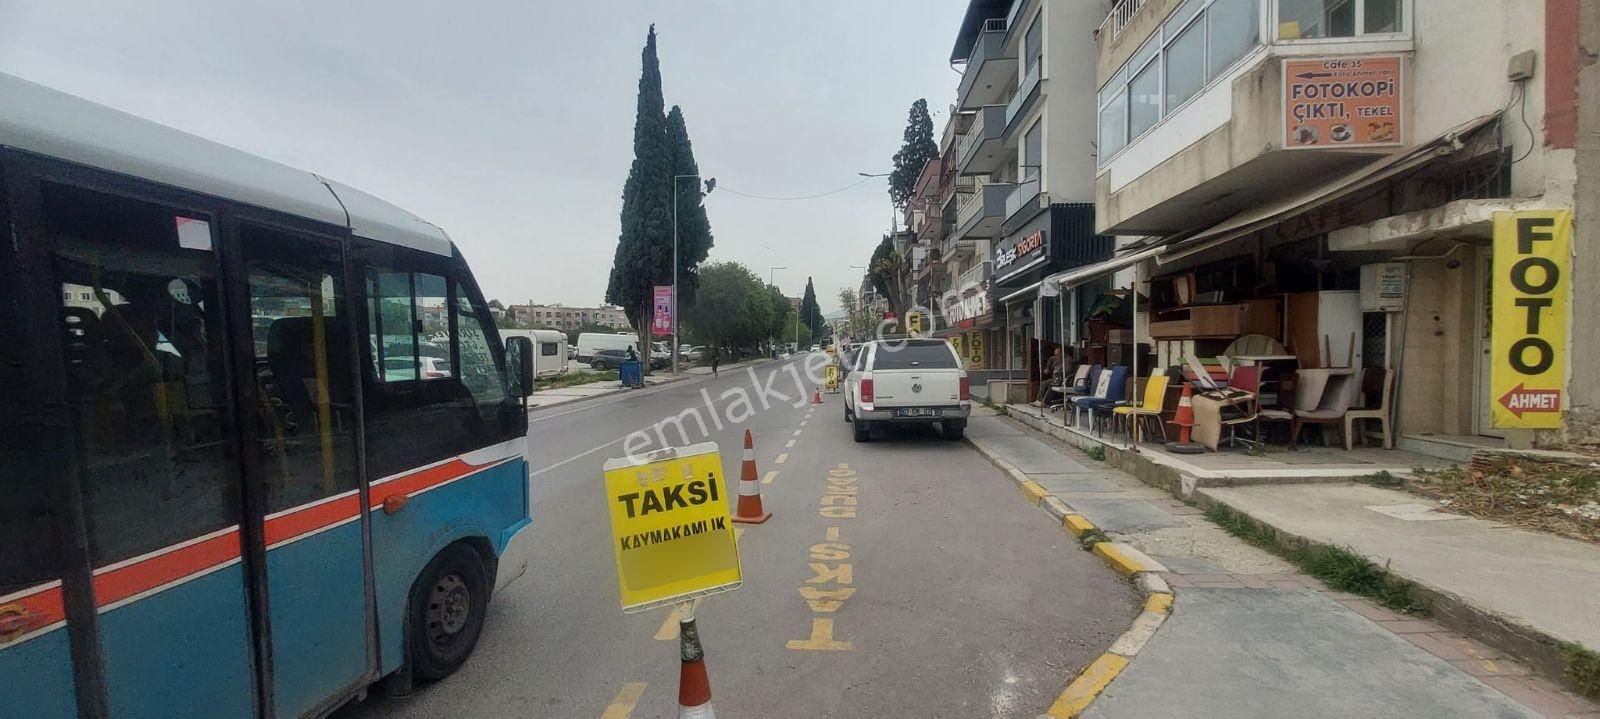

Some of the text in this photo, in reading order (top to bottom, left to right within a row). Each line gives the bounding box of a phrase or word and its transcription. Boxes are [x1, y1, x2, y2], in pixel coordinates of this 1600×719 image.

[1323, 60, 1361, 69] Cafe 35
[1292, 78, 1394, 99] FOTOKOPİ
[1293, 103, 1393, 124] ÇIKTI, TEKEL
[1017, 230, 1043, 258] SİGORTA
[1508, 217, 1560, 376] FOTO
[971, 331, 982, 363] FOTO
[1508, 393, 1558, 409] AHMET
[617, 472, 719, 518] TAKSİ
